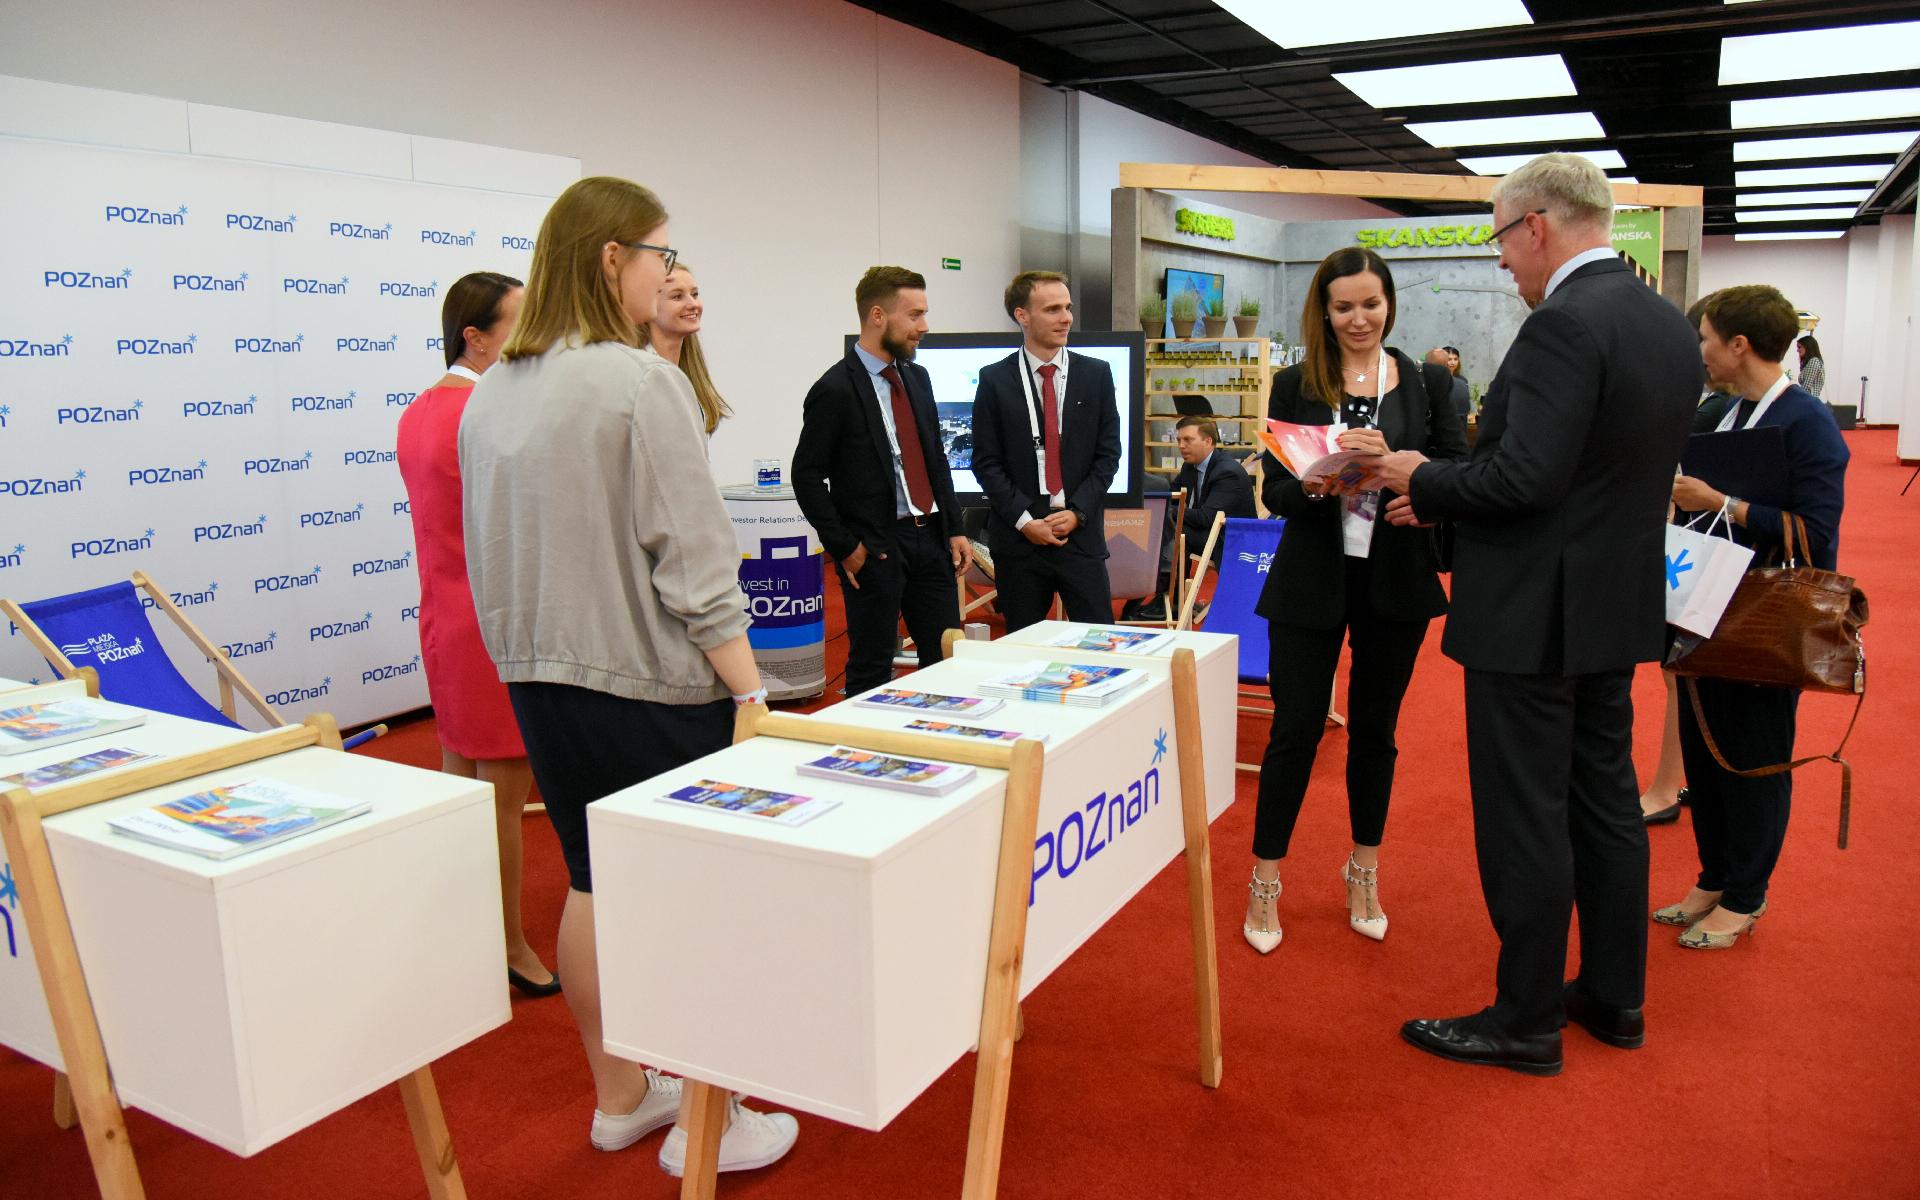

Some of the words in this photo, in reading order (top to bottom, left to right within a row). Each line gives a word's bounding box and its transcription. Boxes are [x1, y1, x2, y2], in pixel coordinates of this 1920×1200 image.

[1356, 224, 1493, 249] SKANSKA
[760, 516, 796, 524] Relations
[777, 577, 789, 591] in
